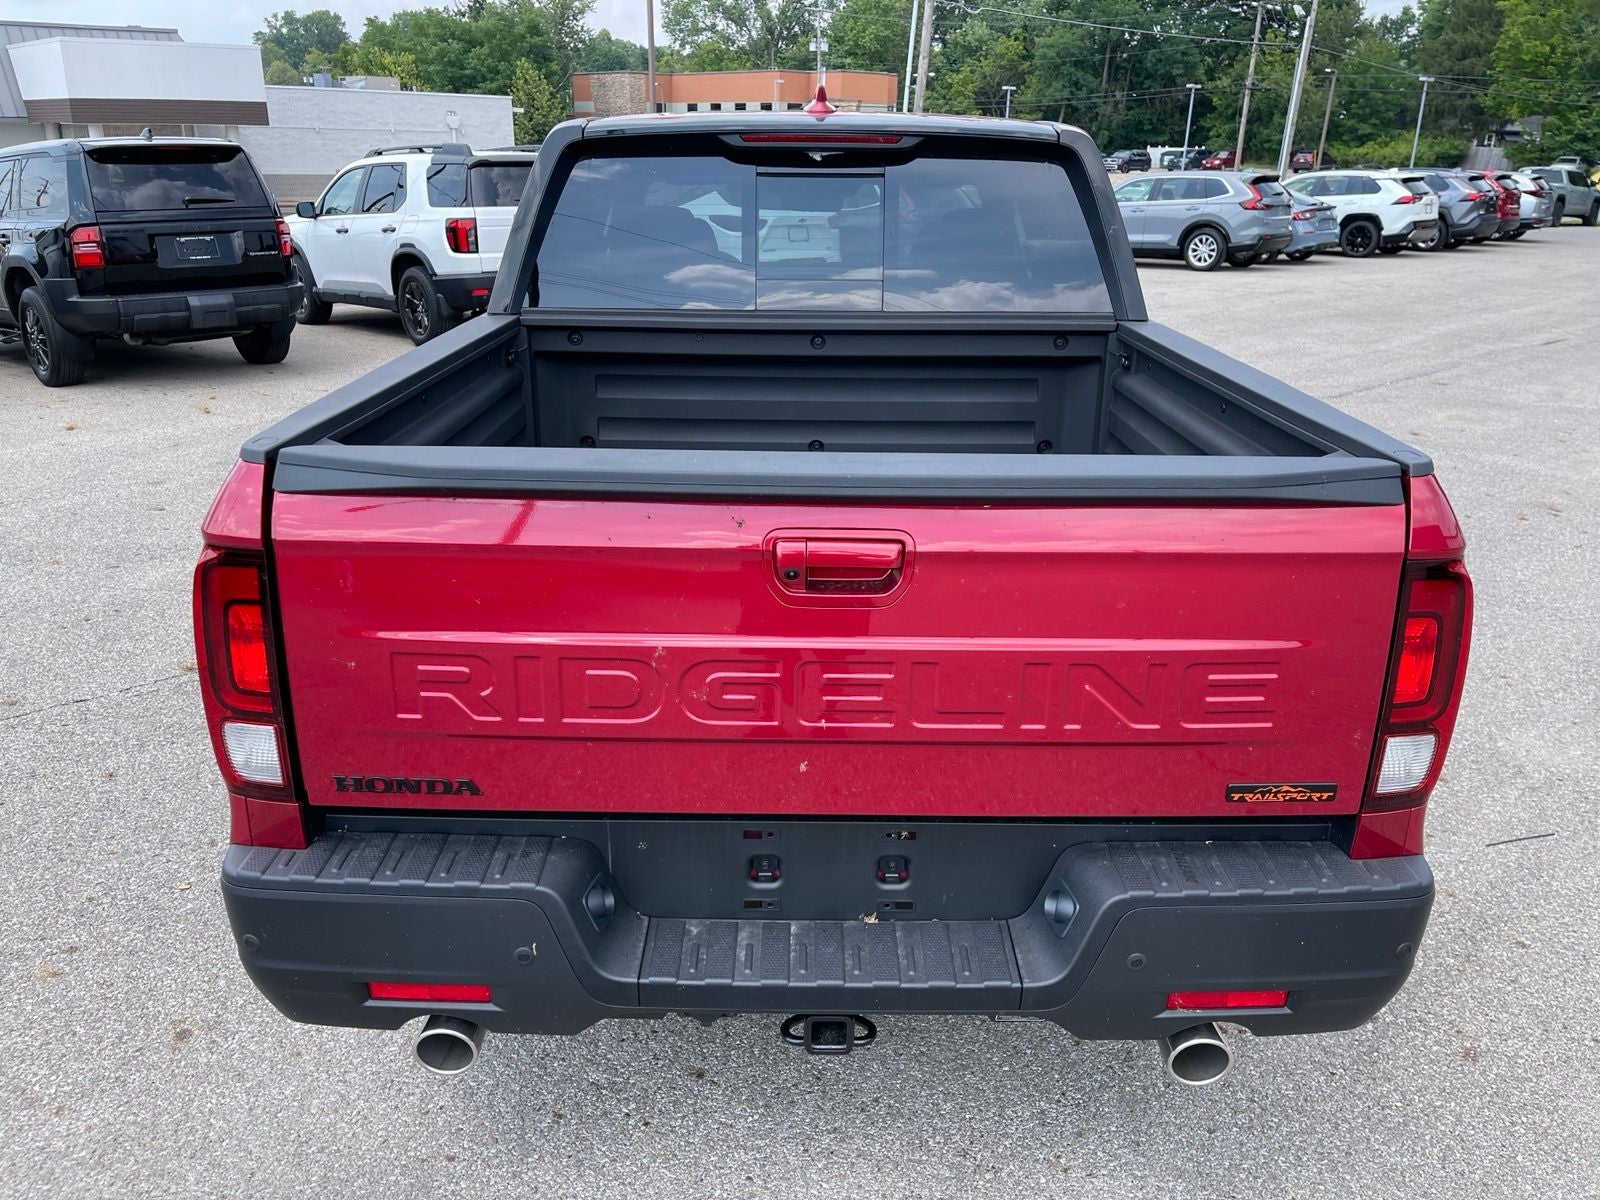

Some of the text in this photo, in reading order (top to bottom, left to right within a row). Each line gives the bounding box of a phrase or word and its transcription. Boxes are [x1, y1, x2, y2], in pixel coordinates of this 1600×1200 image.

[390, 652, 1280, 729] RIDGELINE
[332, 775, 484, 796] HONDA
[1230, 792, 1334, 802] TRAILSPORT
